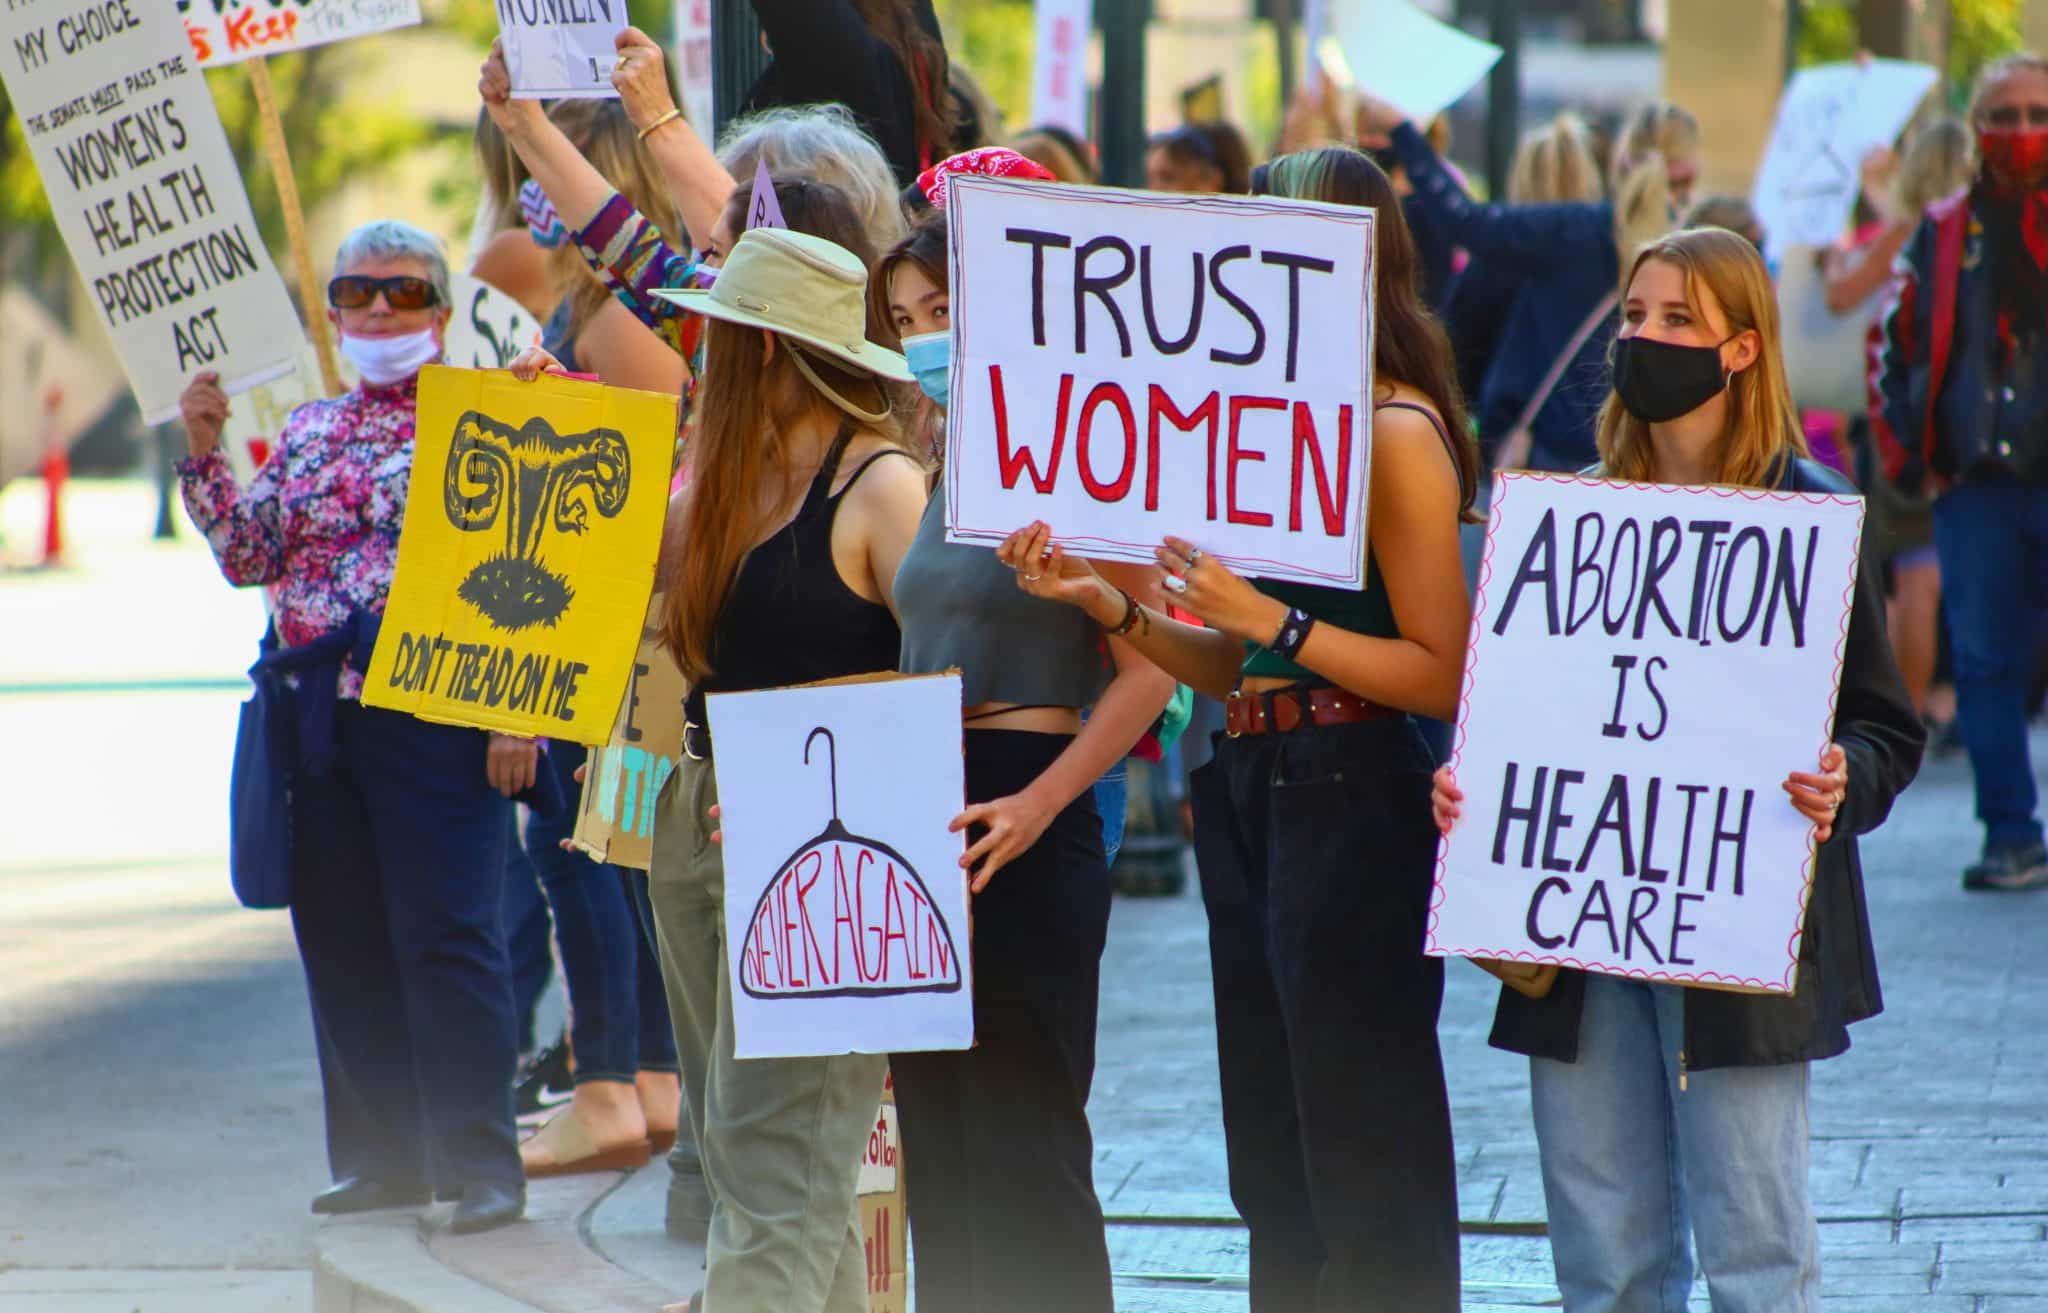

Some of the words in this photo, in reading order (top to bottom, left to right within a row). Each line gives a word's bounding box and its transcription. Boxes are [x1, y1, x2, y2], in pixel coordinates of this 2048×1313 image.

[13, 26, 48, 73] MY
[57, 0, 140, 55] CHOICE
[224, 6, 298, 53] Keep
[27, 114, 49, 136] THE
[90, 82, 125, 113] MUST
[125, 68, 157, 95] PASS
[157, 55, 187, 79] THE
[55, 98, 187, 190] WOMEN'S
[84, 163, 215, 257] HEALTH
[94, 223, 258, 328] PROTECTION
[1005, 227, 1335, 382] TRUST
[172, 306, 229, 372] ACT
[988, 364, 1354, 537] WOMEN
[1491, 507, 1820, 649] ABORTION
[389, 631, 453, 695] DON'T
[445, 642, 514, 708] TREAD
[508, 652, 551, 715] ON
[543, 657, 590, 722] ME
[1601, 655, 1669, 741] IS
[1491, 762, 1755, 896] HEALTH
[747, 850, 831, 989] NEVER
[833, 844, 948, 984] AGAIN
[1525, 876, 1706, 965] CARE
